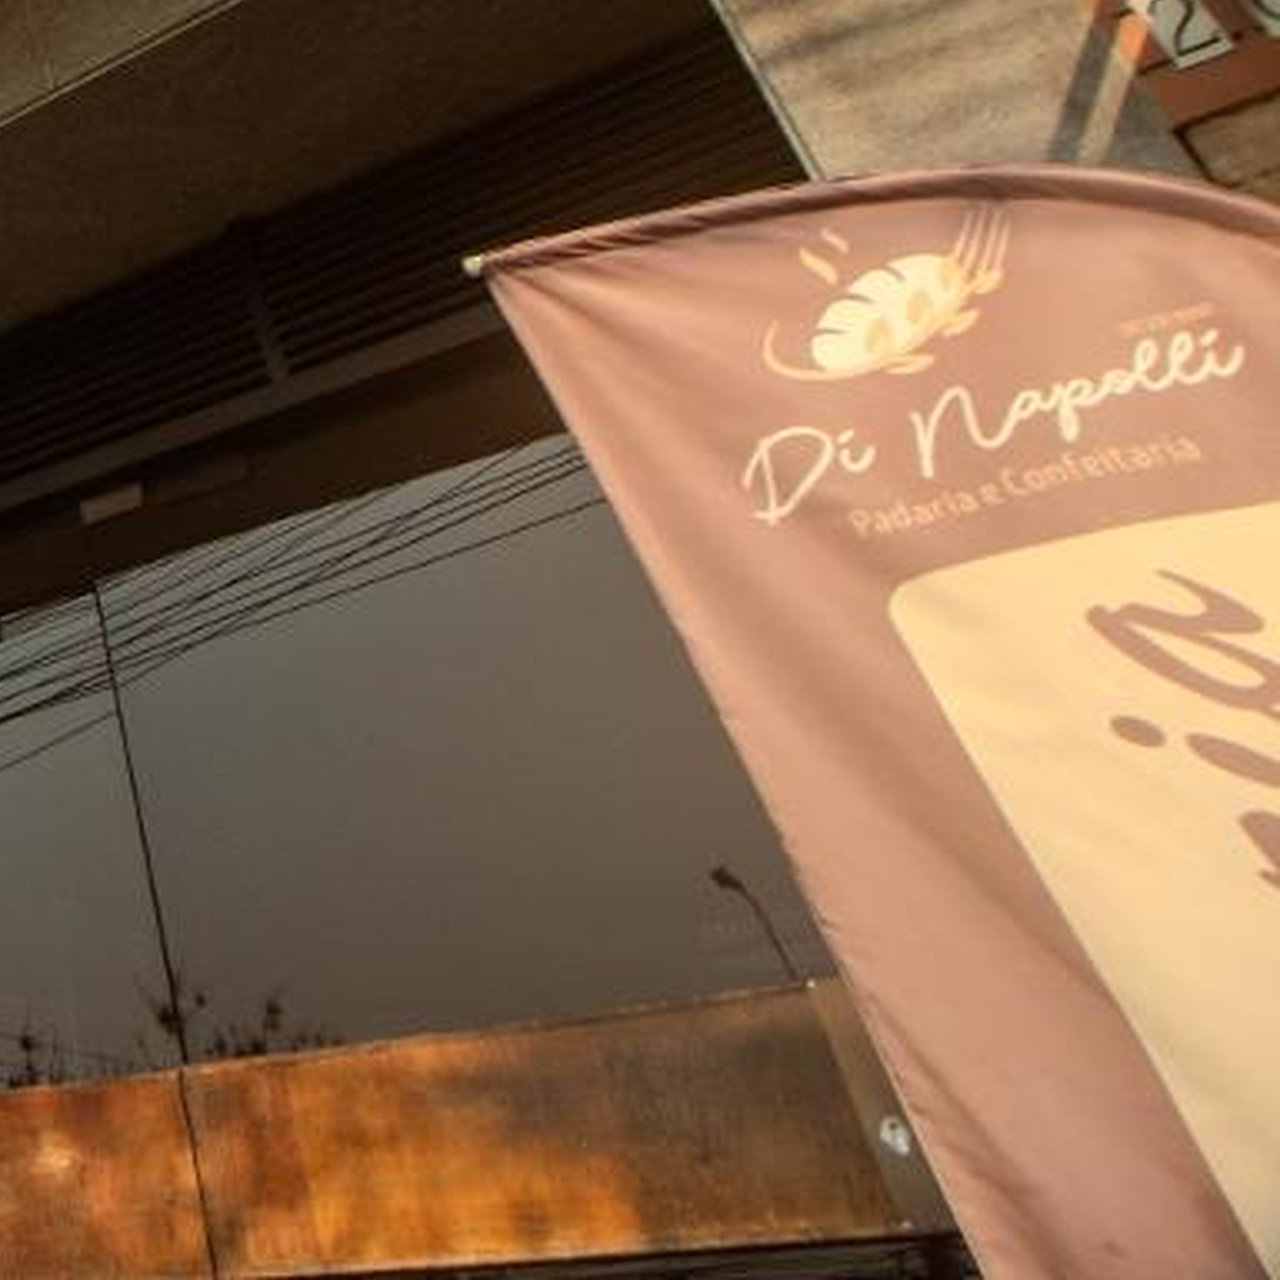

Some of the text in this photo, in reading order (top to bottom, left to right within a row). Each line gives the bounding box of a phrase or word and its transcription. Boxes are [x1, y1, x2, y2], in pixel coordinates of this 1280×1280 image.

[742, 328, 1244, 526] Di Napolli
[850, 434, 1204, 539] Padaria e Confeitaria
